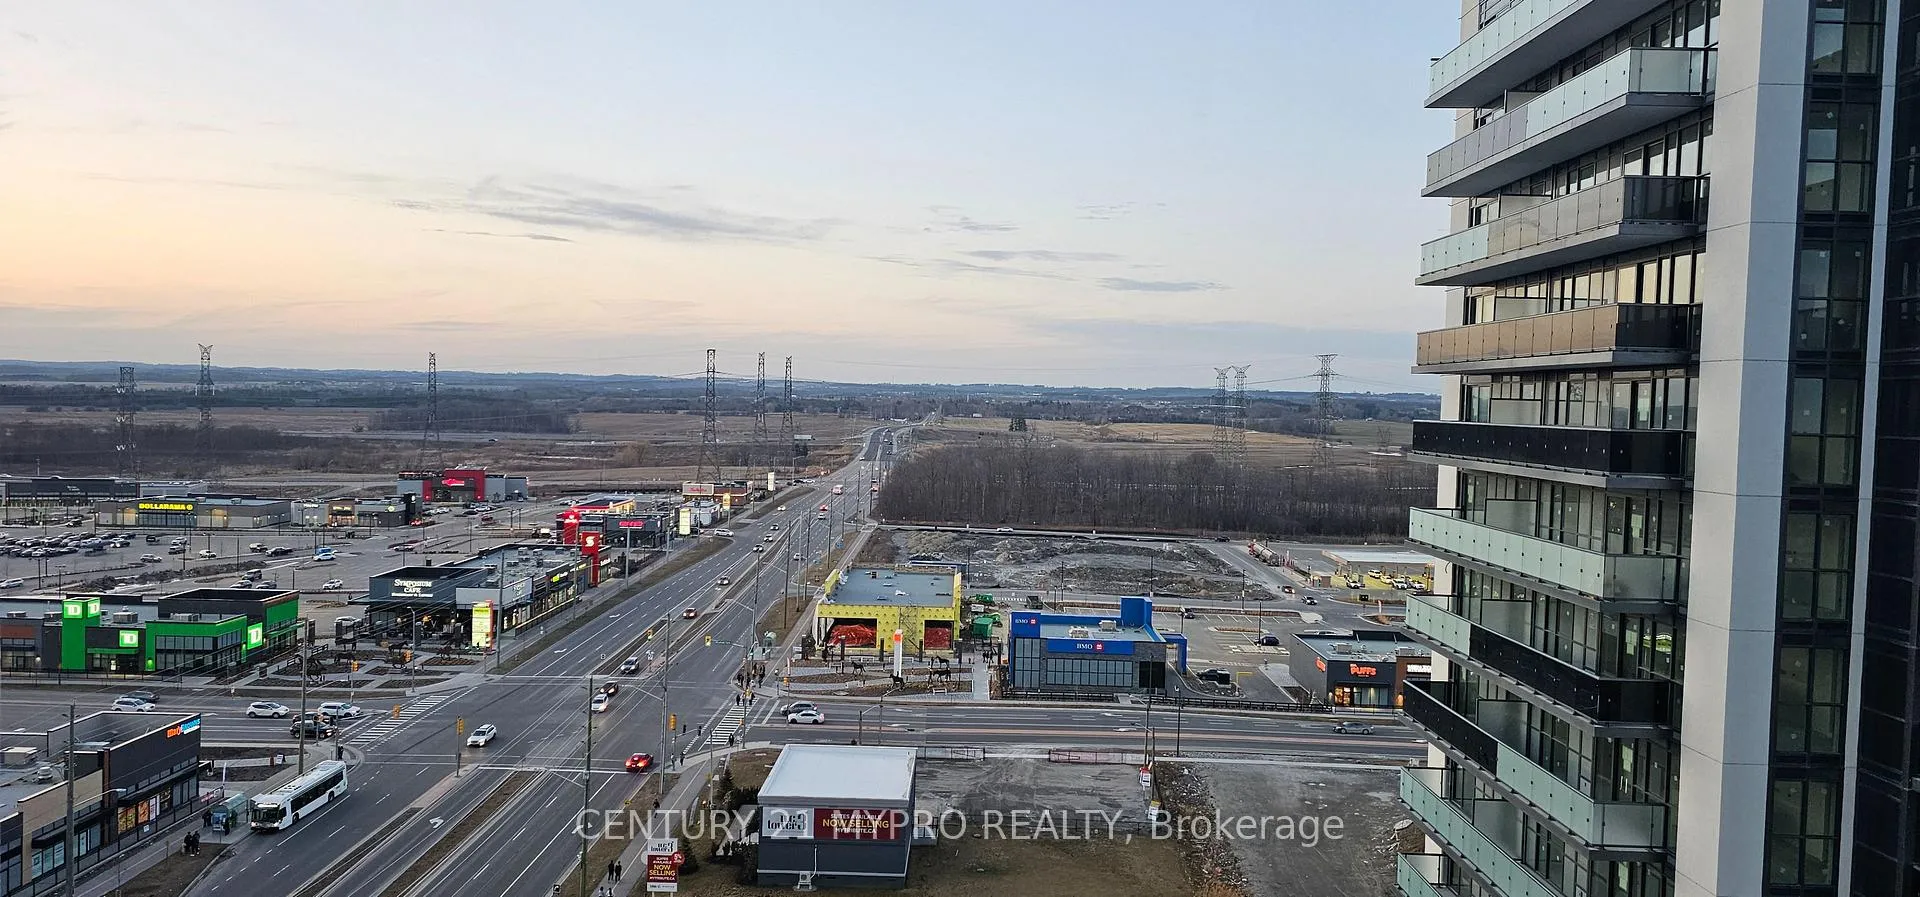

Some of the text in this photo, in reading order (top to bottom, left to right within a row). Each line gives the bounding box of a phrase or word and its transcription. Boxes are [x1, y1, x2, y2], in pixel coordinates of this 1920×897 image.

[394, 579, 433, 588] SYMPOSIUM
[65, 603, 82, 616] TD
[88, 602, 100, 615] TD
[120, 632, 138, 645] TD
[247, 627, 262, 645] TD
[1350, 665, 1377, 676] PUFFS
[851, 813, 882, 821] AVAILABLE
[822, 818, 890, 829] NOW SELLING
[648, 869, 676, 877] SELLING
